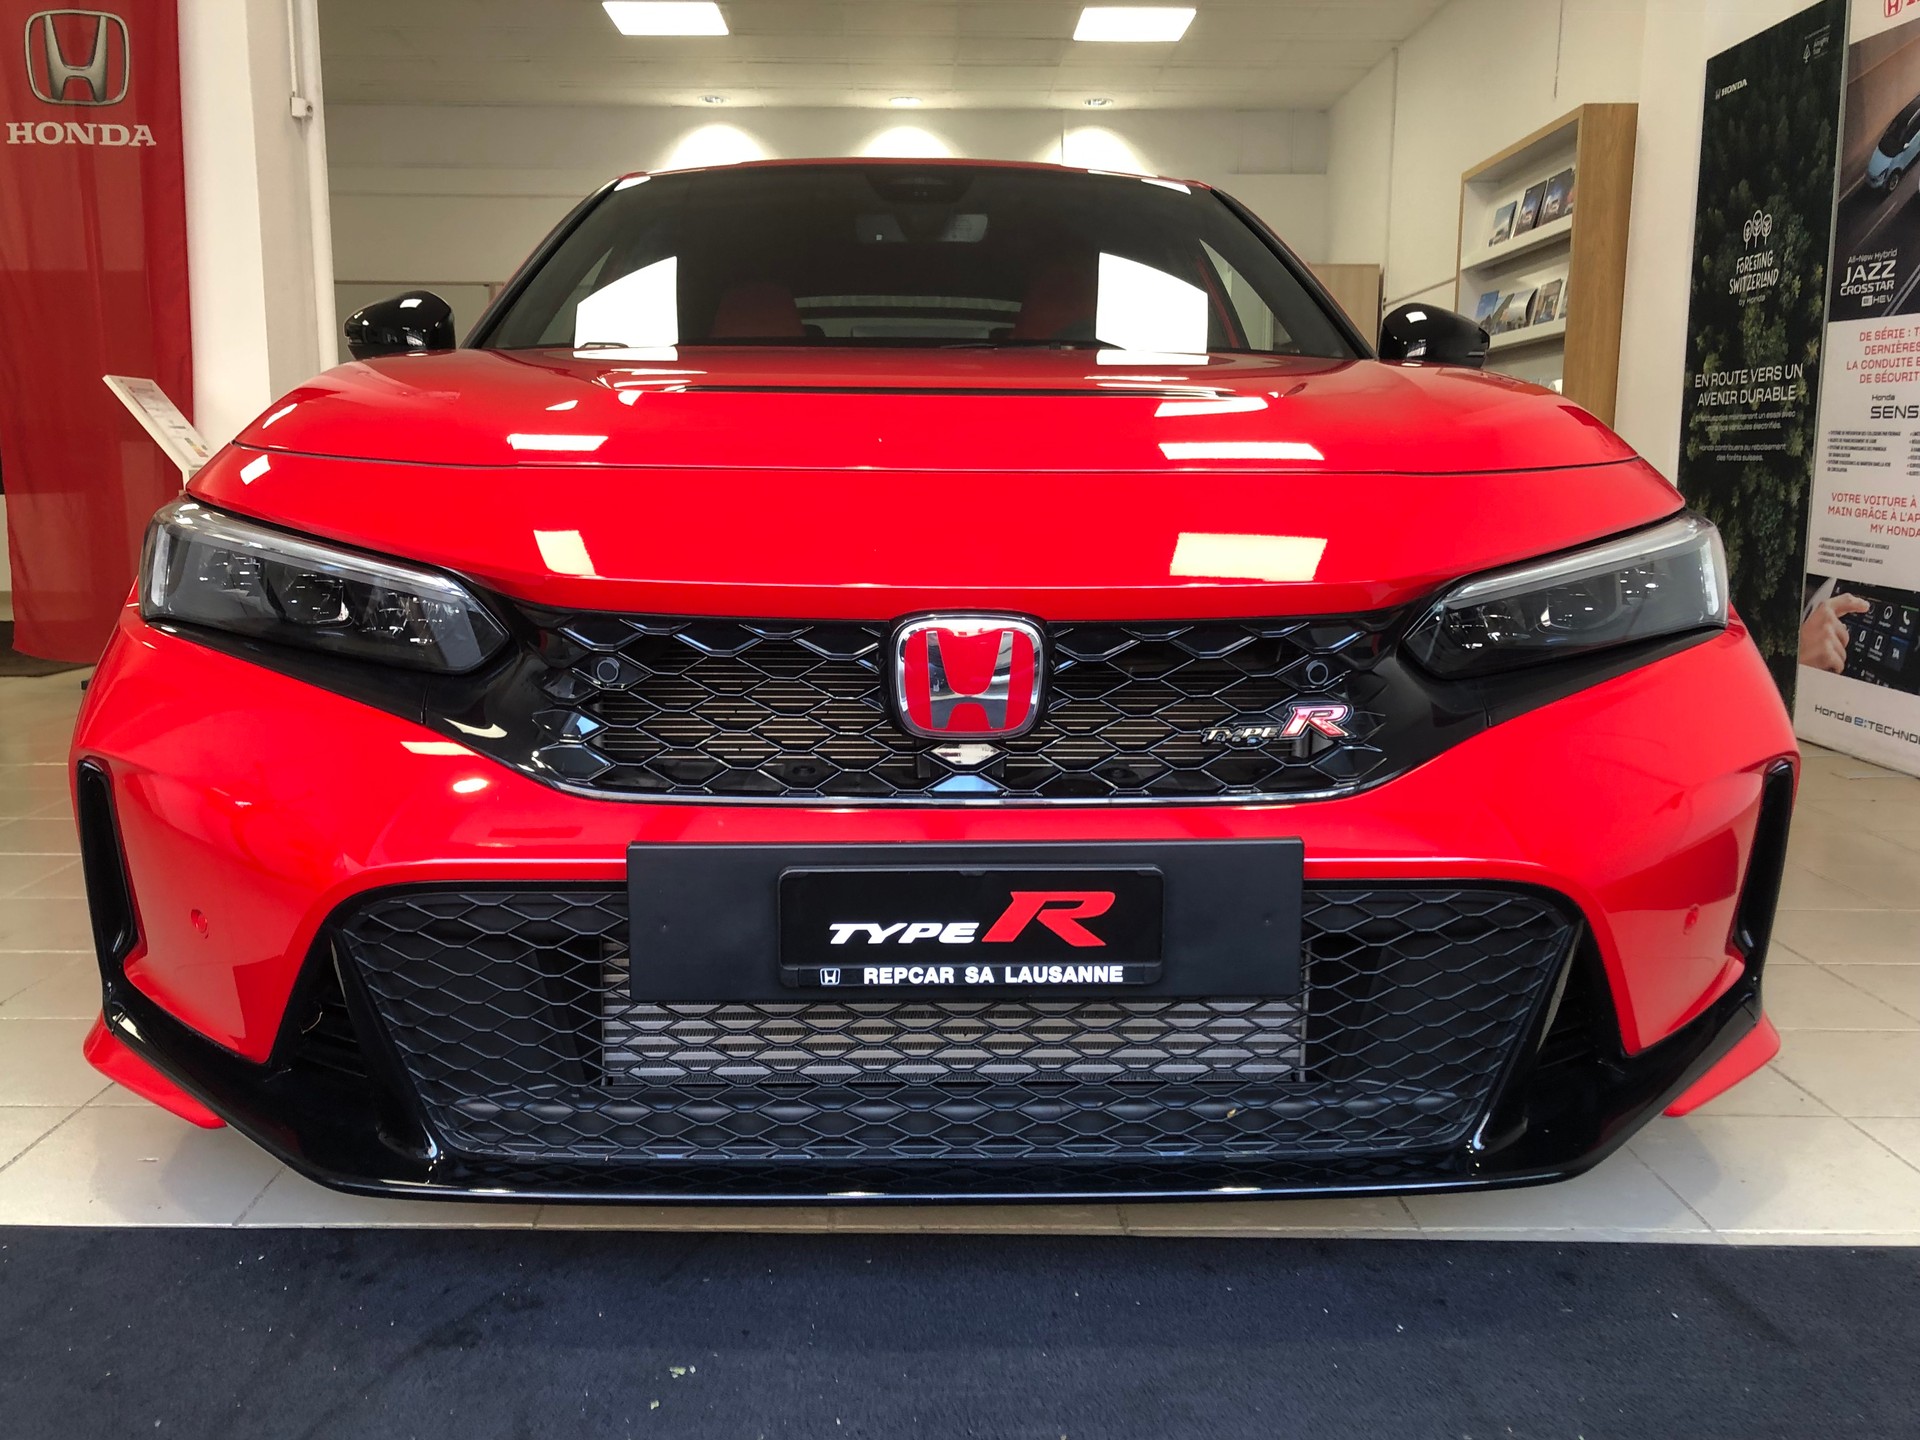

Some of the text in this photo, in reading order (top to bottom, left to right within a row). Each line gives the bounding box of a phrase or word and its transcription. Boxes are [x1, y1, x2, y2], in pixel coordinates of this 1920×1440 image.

[1721, 78, 1747, 97] HONDA
[6, 121, 156, 147] HONDA
[1874, 248, 1898, 261] Hybrid
[1729, 268, 1779, 295] SWITZERLAND
[1841, 260, 1896, 287] JAZZ
[1840, 280, 1895, 296] CROSSTAR
[1873, 294, 1894, 304] HEV
[1859, 331, 1872, 341] DE
[1874, 326, 1905, 341] SÉRIE
[1864, 340, 1920, 355] DERNIÈRES
[1846, 361, 1858, 370] LA
[1861, 357, 1913, 370] CONDUITE
[1695, 363, 1803, 388] EN ROUTE VERS UN
[1859, 374, 1872, 384] DE
[1697, 384, 1797, 407] AVENIR DURABLE
[1831, 492, 1917, 508] VOTRE VOITURE À
[1828, 506, 1852, 516] MAIN
[1854, 507, 1888, 520] GRÂCE
[1890, 508, 1897, 520] À
[1870, 523, 1884, 533] MY
[1201, 703, 1352, 742] TYPE R
[1814, 704, 1920, 745] Honda e:TECHNO
[829, 891, 1116, 947] TYPE R
[863, 967, 954, 984] REPCAR
[964, 966, 995, 984] SA
[1004, 965, 1124, 984] LAUSANNE
